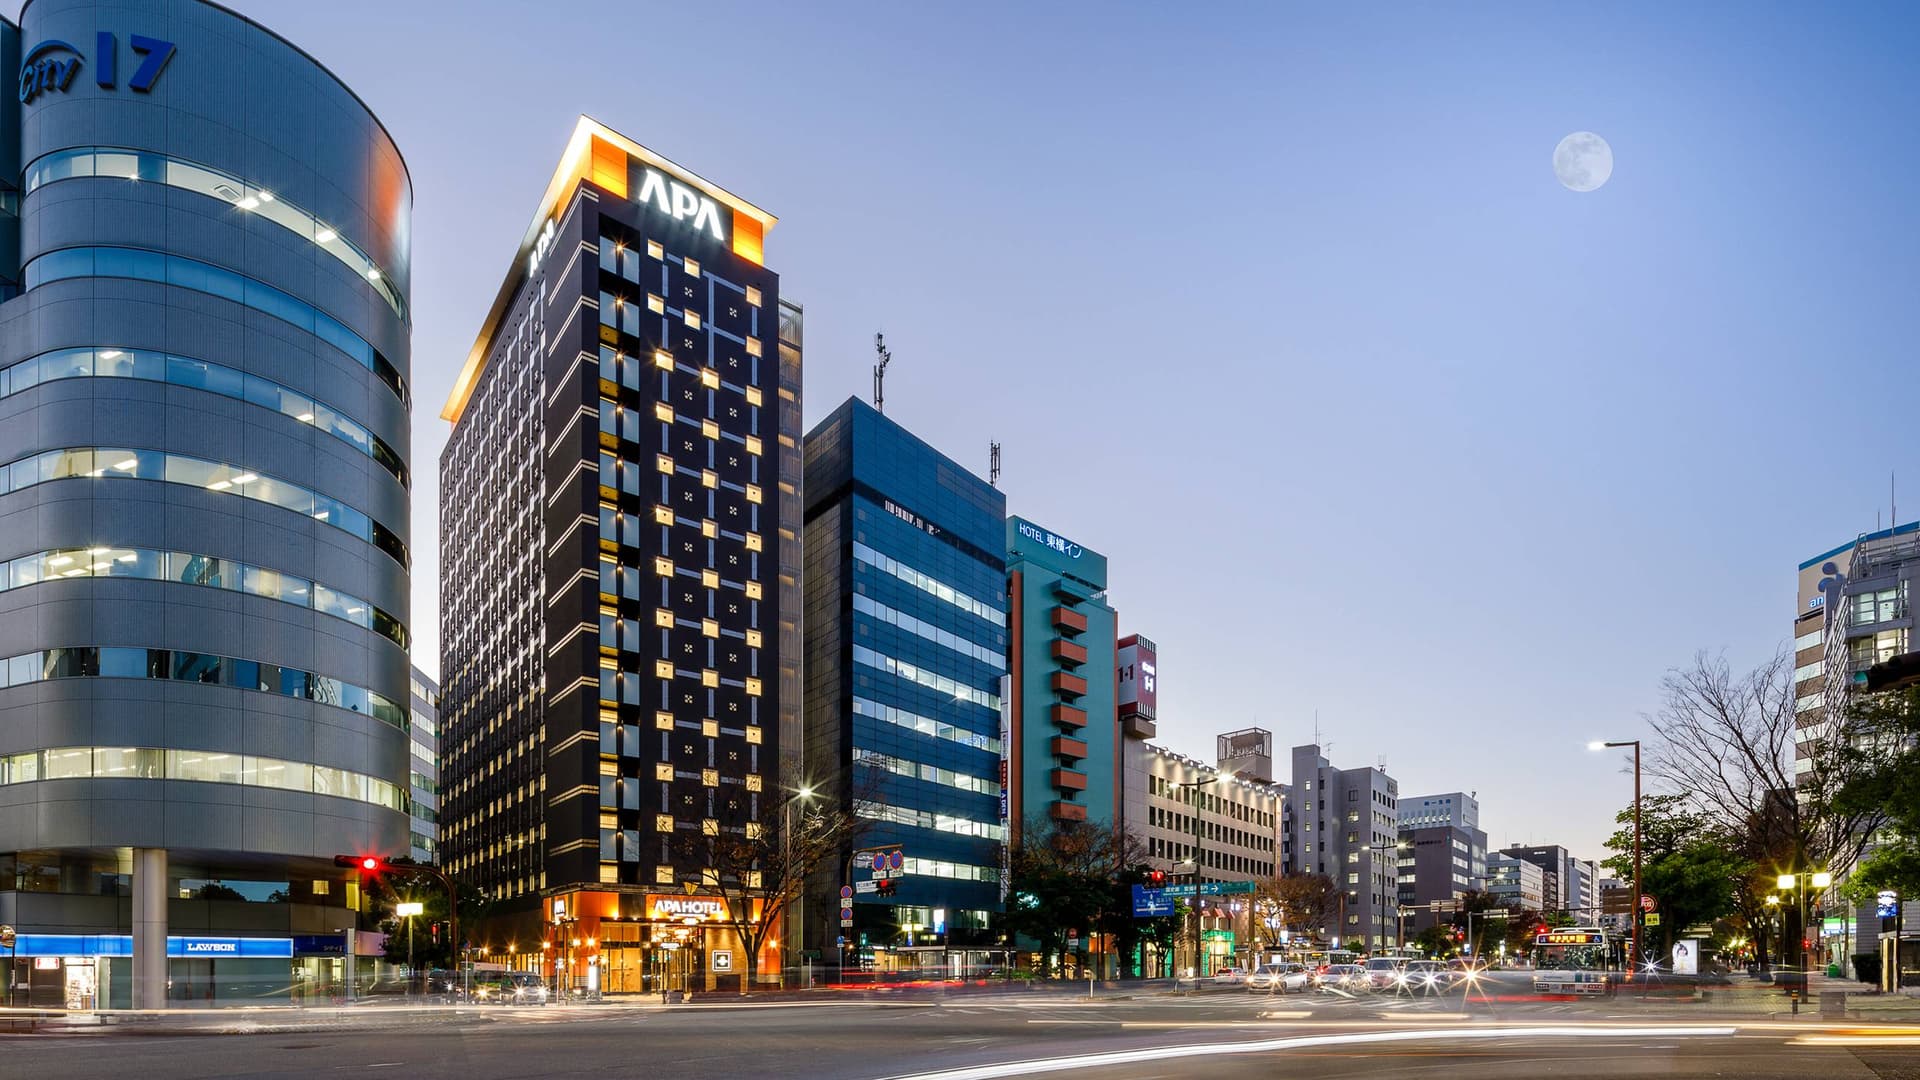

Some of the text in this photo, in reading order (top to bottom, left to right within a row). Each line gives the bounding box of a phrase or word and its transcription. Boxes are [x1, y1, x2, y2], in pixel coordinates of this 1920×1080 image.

[19, 31, 177, 105] City 17
[638, 167, 725, 241] APA
[1019, 522, 1082, 559] HOTEL 東横イン
[654, 899, 724, 914] APA HOTEL
[187, 943, 237, 952] LAWSON
